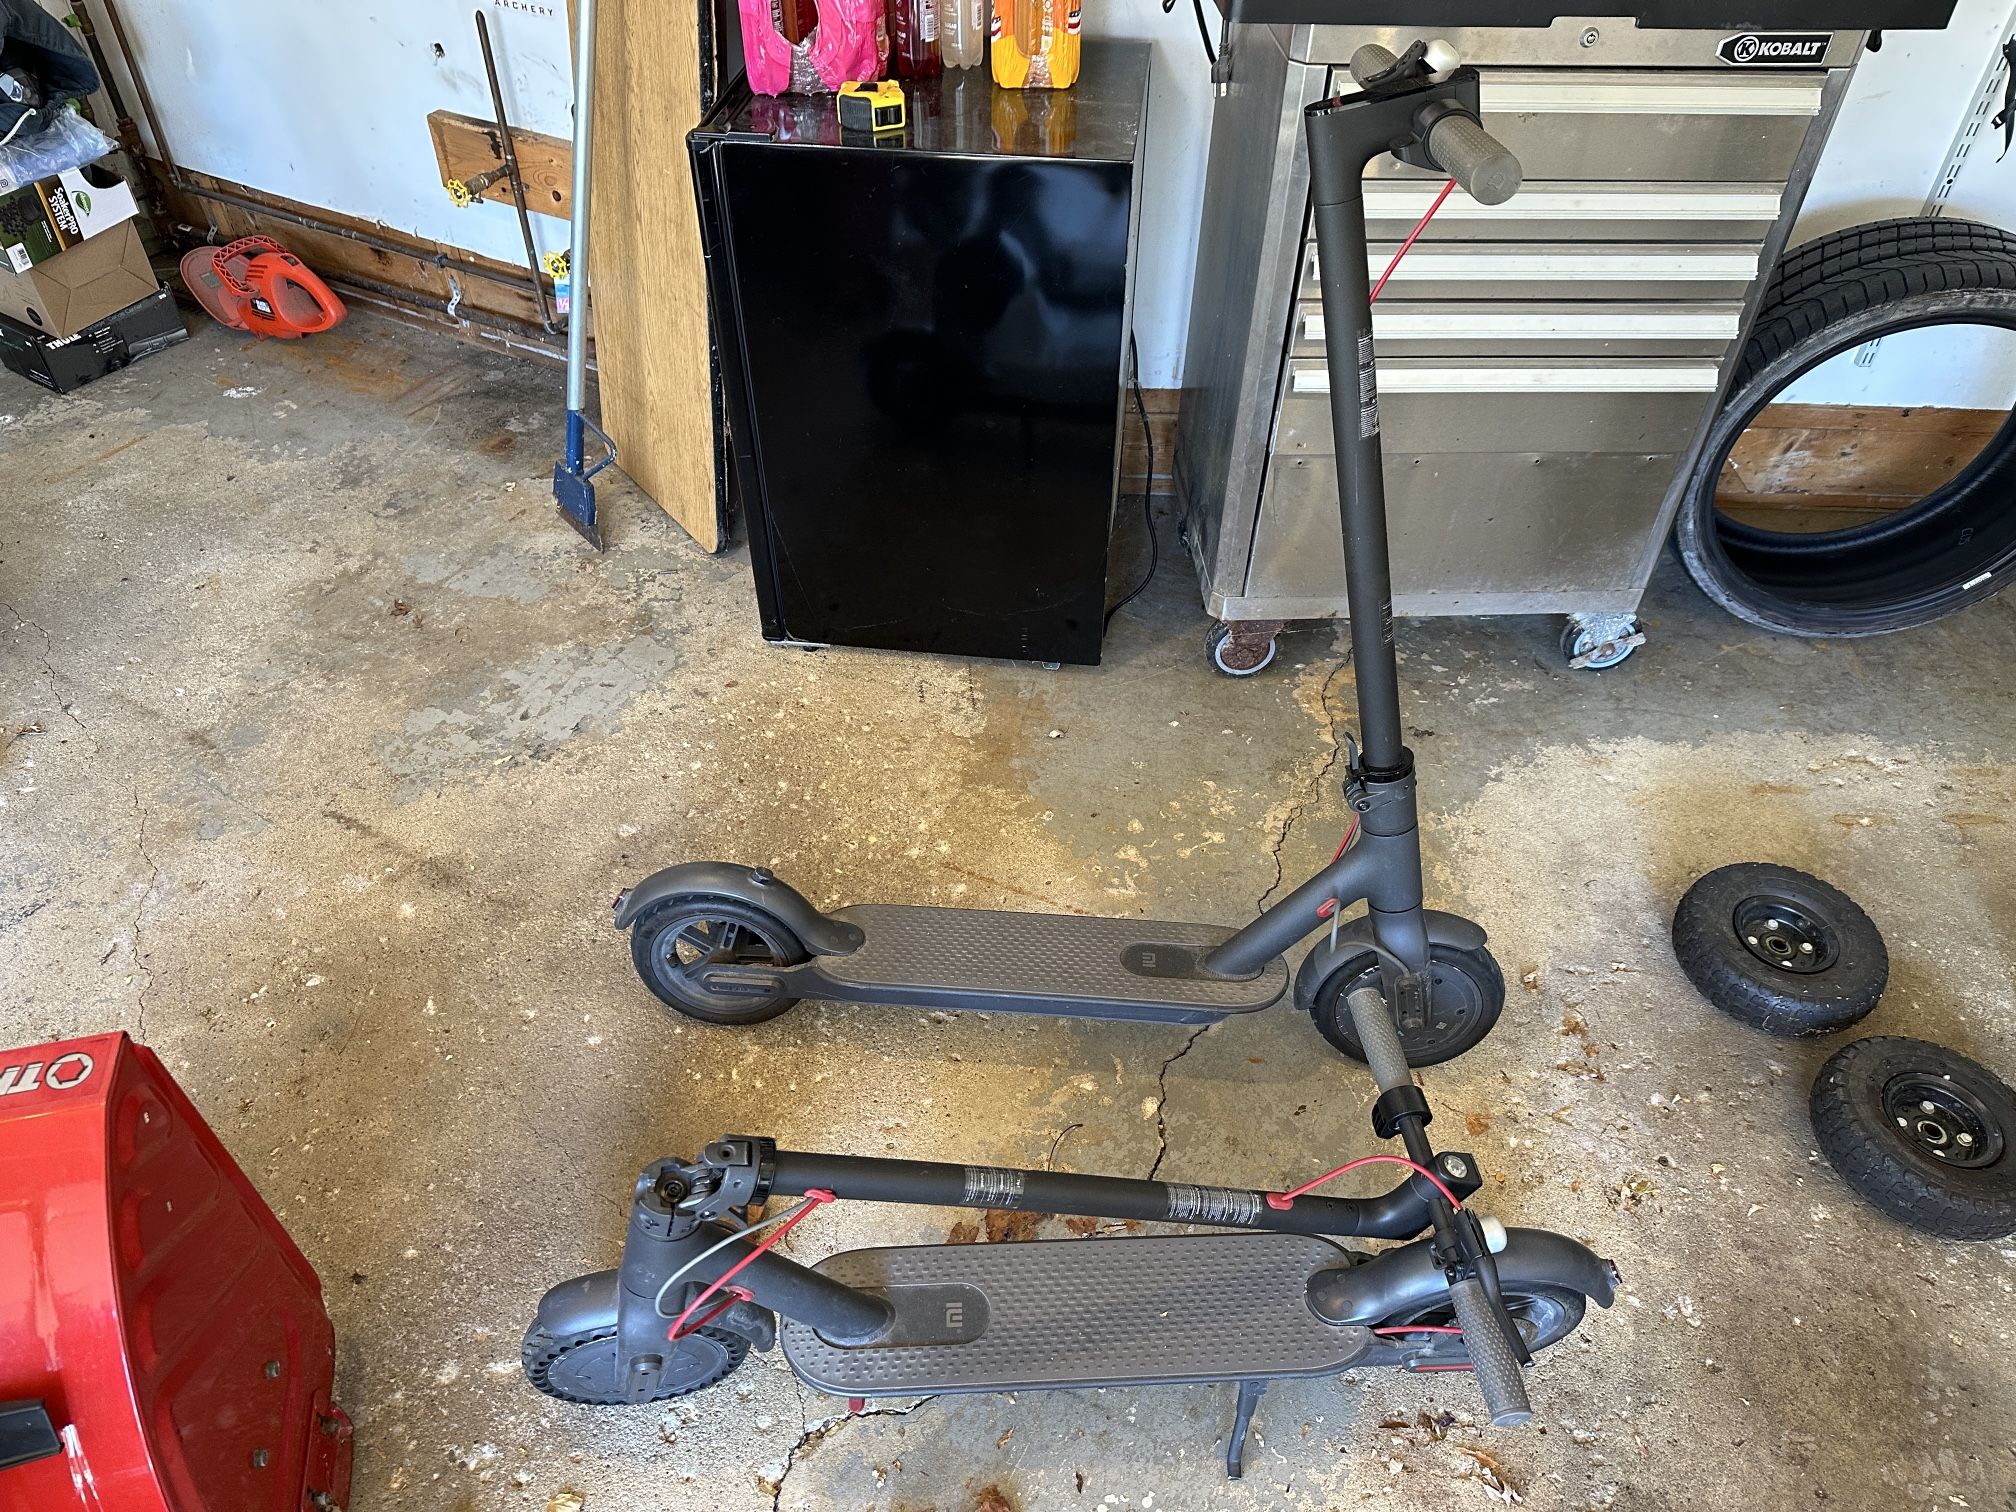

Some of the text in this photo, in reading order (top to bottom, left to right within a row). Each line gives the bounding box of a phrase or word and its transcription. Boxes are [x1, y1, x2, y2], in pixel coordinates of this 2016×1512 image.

[494, 0, 553, 16] ARCHERY
[1757, 41, 1822, 57] KOBALT
[48, 197, 69, 231] SYSTEM
[54, 186, 79, 235] SoakerPRO
